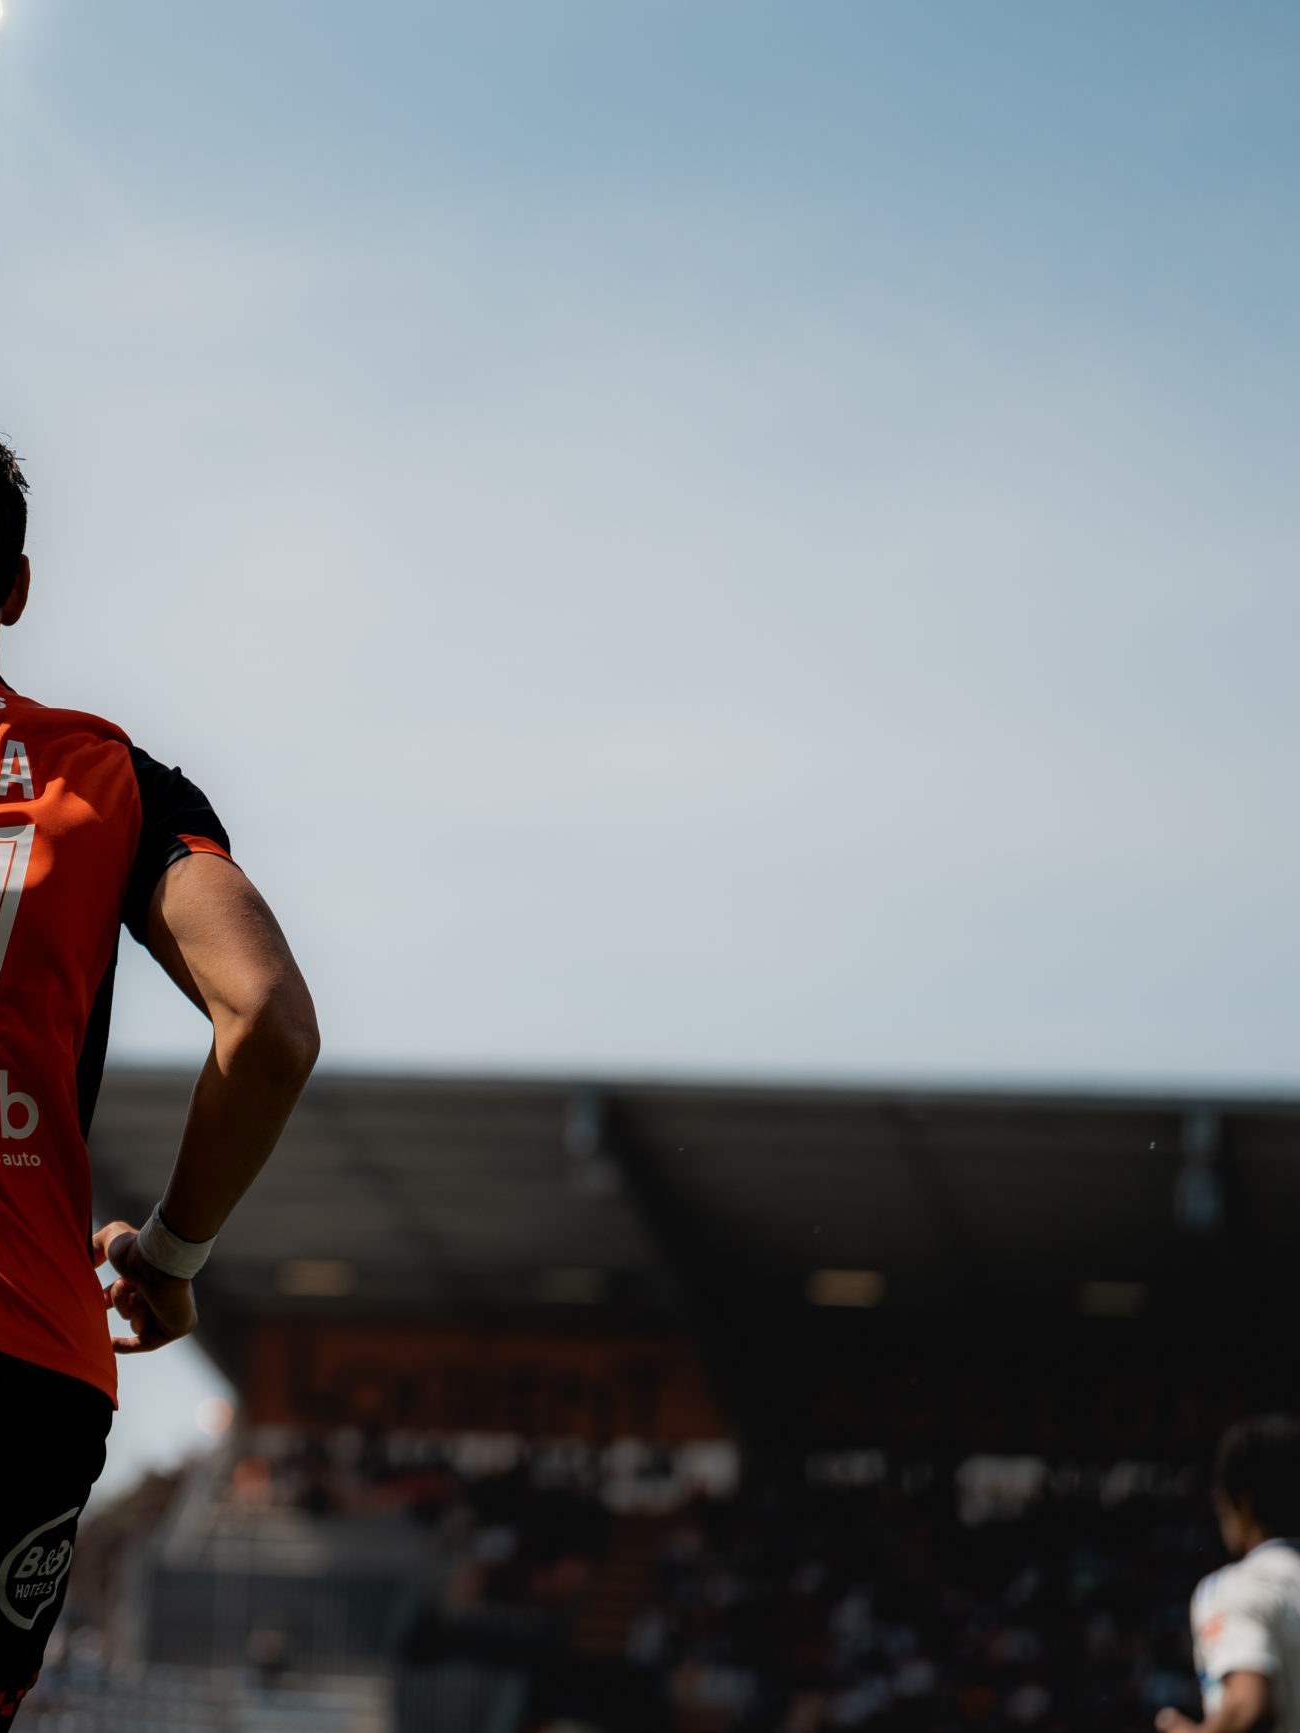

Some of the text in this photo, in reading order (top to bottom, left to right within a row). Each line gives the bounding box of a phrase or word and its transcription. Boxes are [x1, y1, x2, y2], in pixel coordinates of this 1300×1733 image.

[2, 1151, 41, 1167] auto
[12, 1538, 70, 1579] B&B
[14, 1580, 54, 1599] HOTELS
